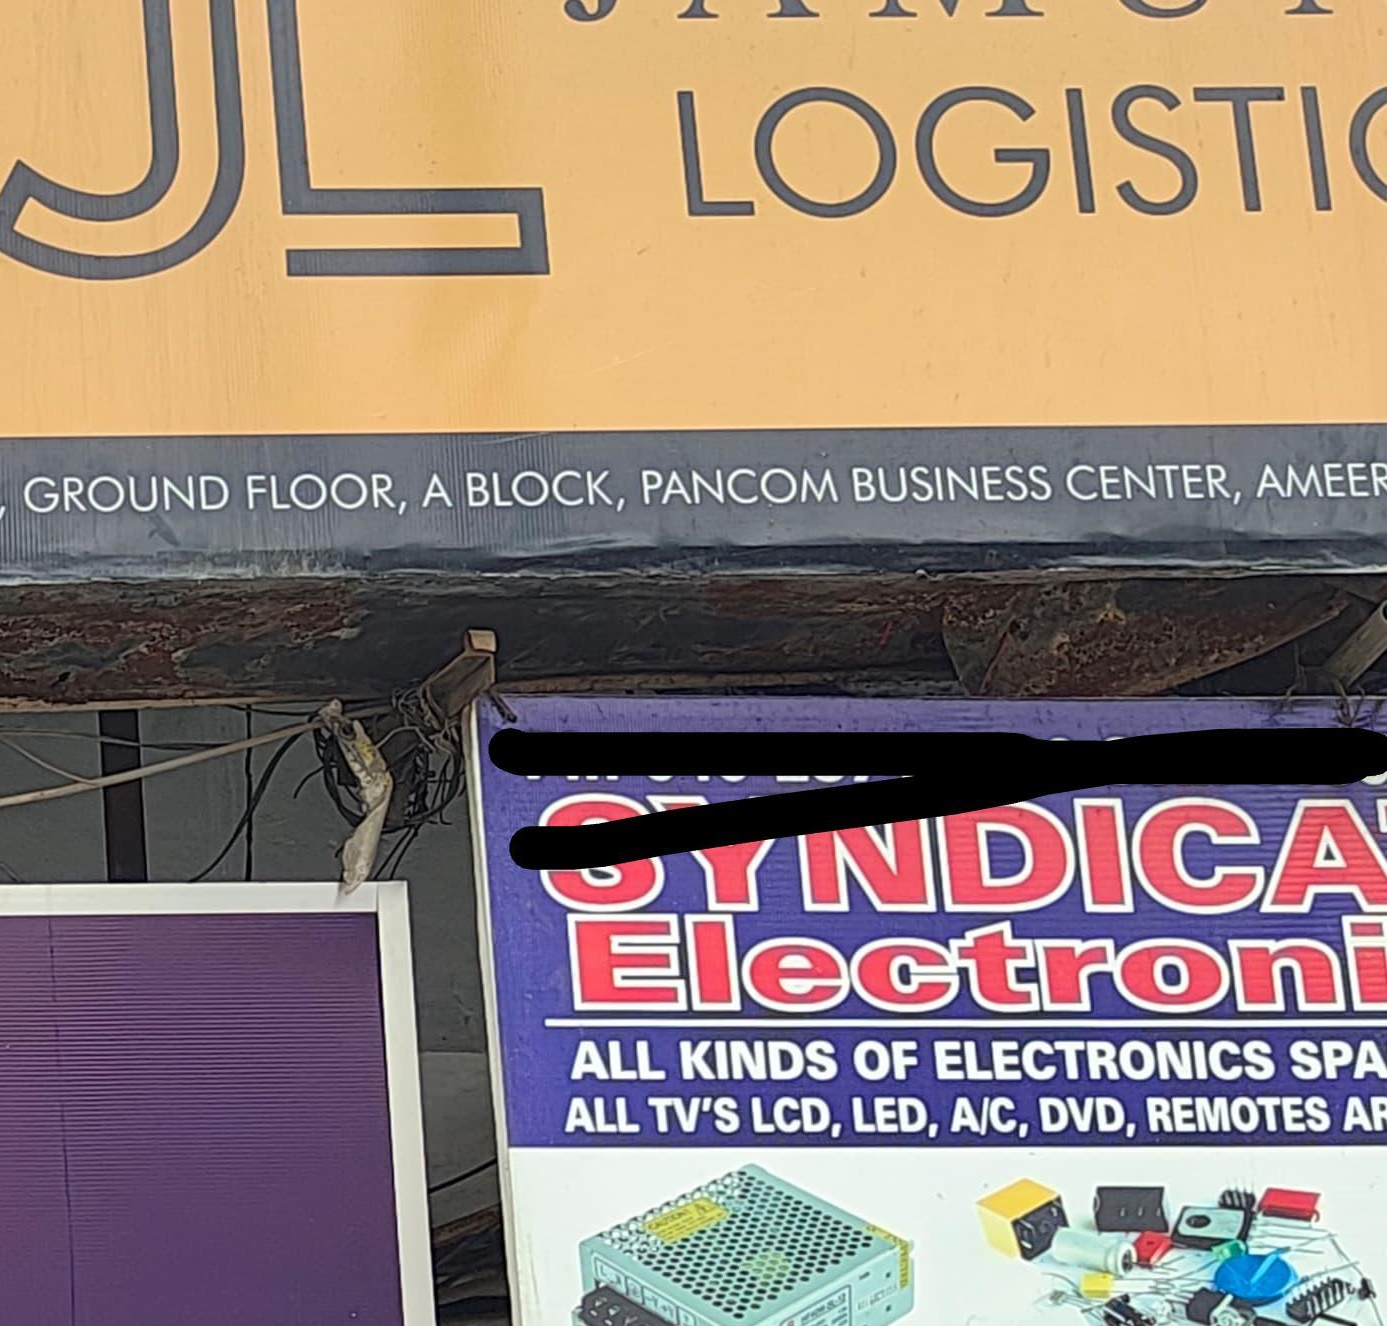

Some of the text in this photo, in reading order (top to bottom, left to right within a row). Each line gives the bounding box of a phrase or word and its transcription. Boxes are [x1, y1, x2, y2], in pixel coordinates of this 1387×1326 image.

[24, 474, 230, 514] GROUND
[247, 473, 408, 517] FLOOR,
[422, 472, 453, 509] A
[468, 469, 627, 513] BLOCK,
[642, 466, 838, 507] PANCOM
[852, 464, 1053, 504] BUSINESS
[1066, 462, 1242, 505] CENTER,
[537, 793, 1387, 916] SYNDICA
[571, 1042, 666, 1082] ALL
[680, 1041, 838, 1082] KINDS
[853, 1041, 919, 1082] OF
[935, 1040, 1276, 1081] ELECTRONICS
[564, 1097, 640, 1134] ALL
[752, 1097, 843, 1138] LCD,
[853, 1097, 940, 1137] LED,
[950, 1097, 1028, 1137] A/C,
[1040, 1096, 1137, 1137] DVD,
[1148, 1095, 1332, 1133] REMOTES
